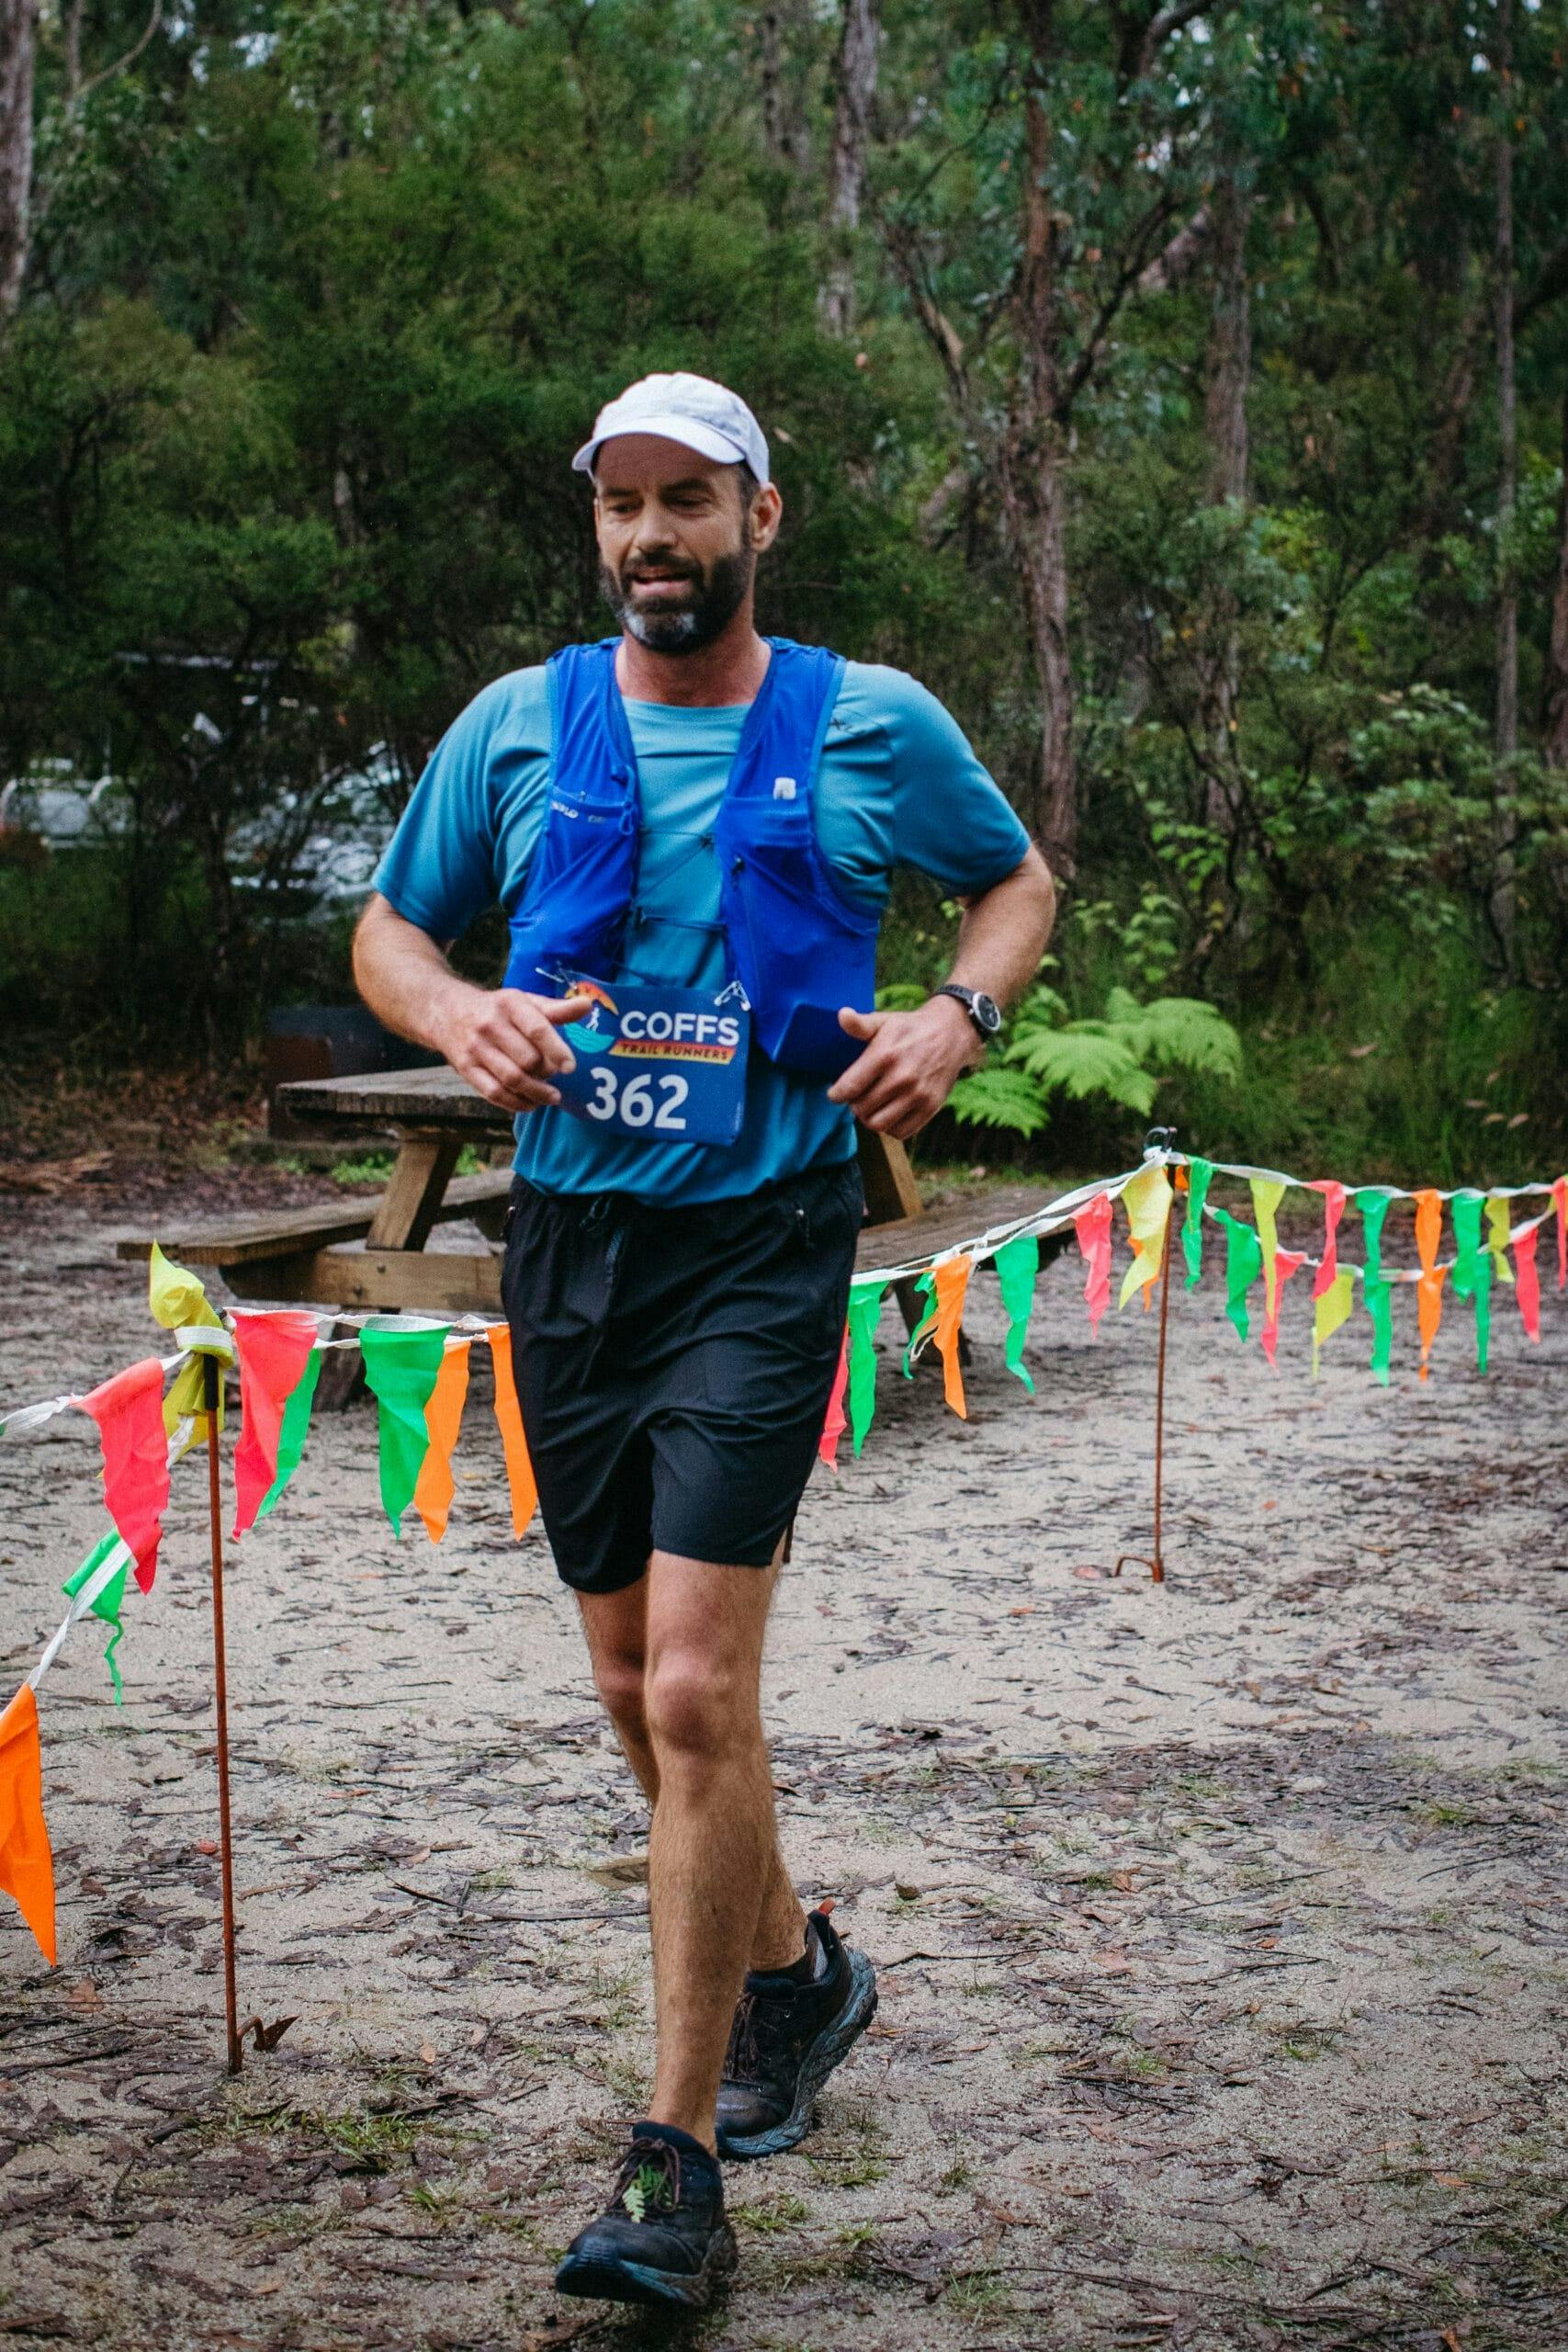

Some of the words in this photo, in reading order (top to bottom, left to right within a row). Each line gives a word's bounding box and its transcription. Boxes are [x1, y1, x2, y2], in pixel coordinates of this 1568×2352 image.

[621, 1012, 739, 1046] COFFS
[622, 1044, 660, 1055] TRAIL
[663, 1046, 728, 1061] RUNNERS
[587, 1068, 689, 1129] 362
